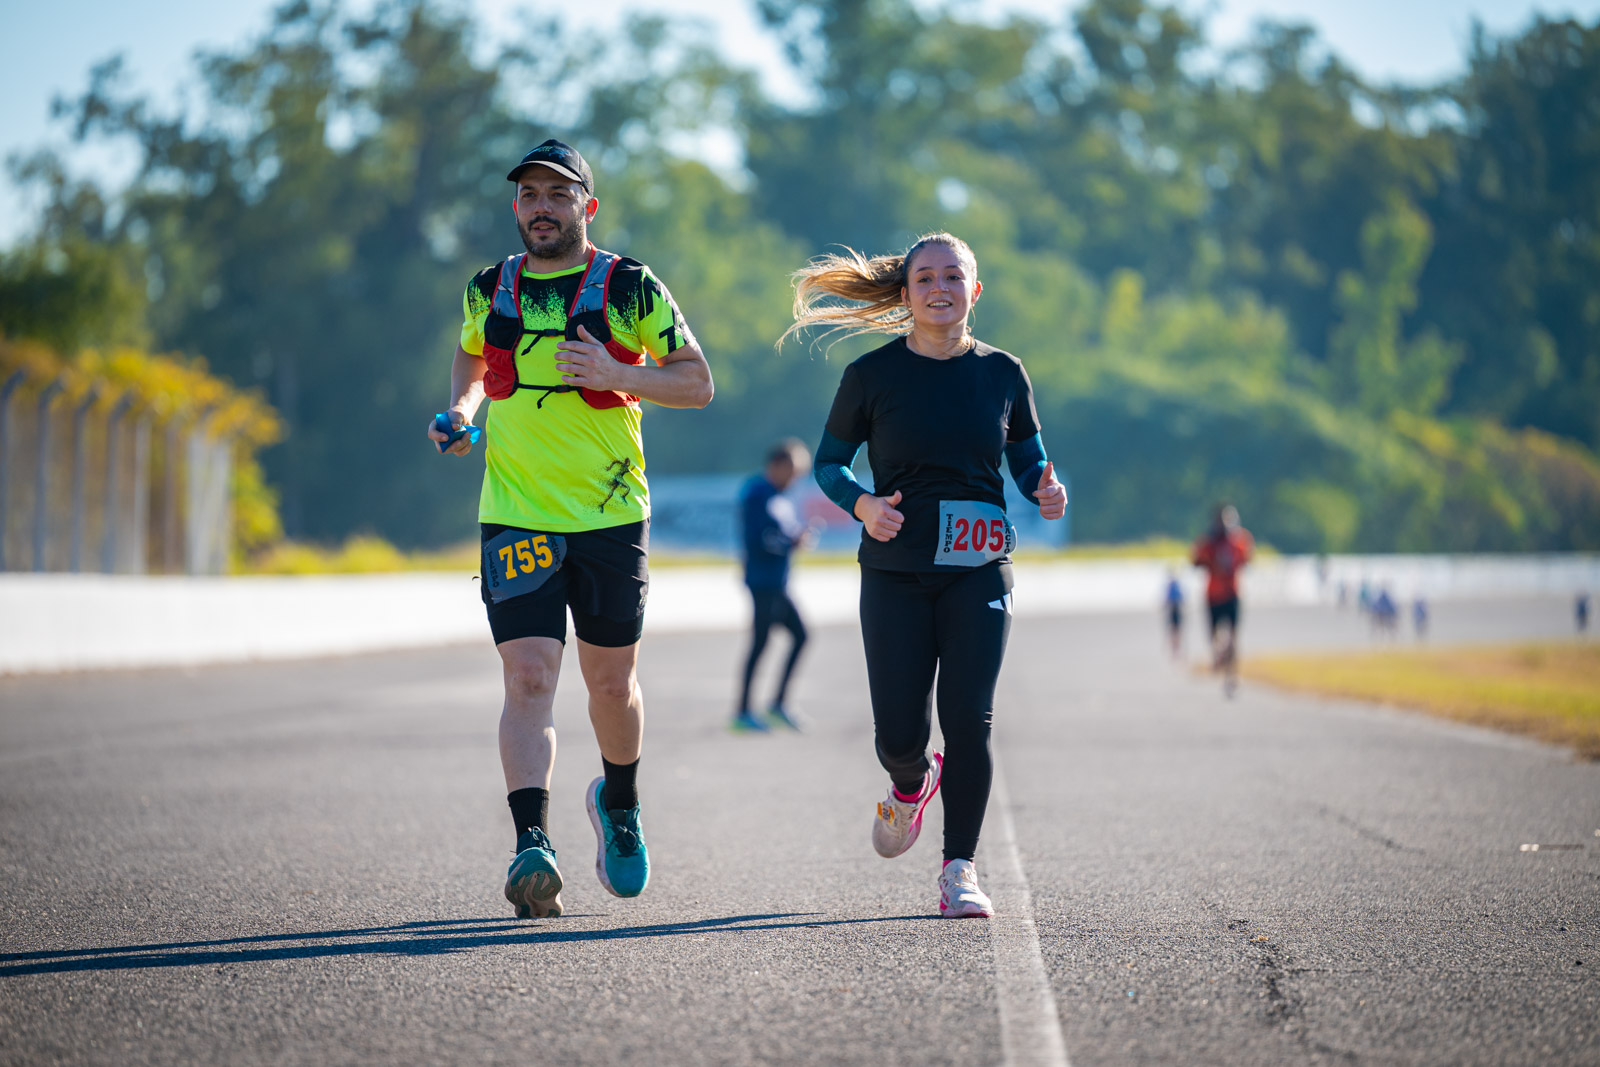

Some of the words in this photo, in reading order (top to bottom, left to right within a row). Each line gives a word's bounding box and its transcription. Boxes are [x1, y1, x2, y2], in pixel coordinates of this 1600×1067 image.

[943, 513, 953, 553] TIEMPO
[953, 518, 1004, 552] 205
[498, 534, 553, 580] 755
